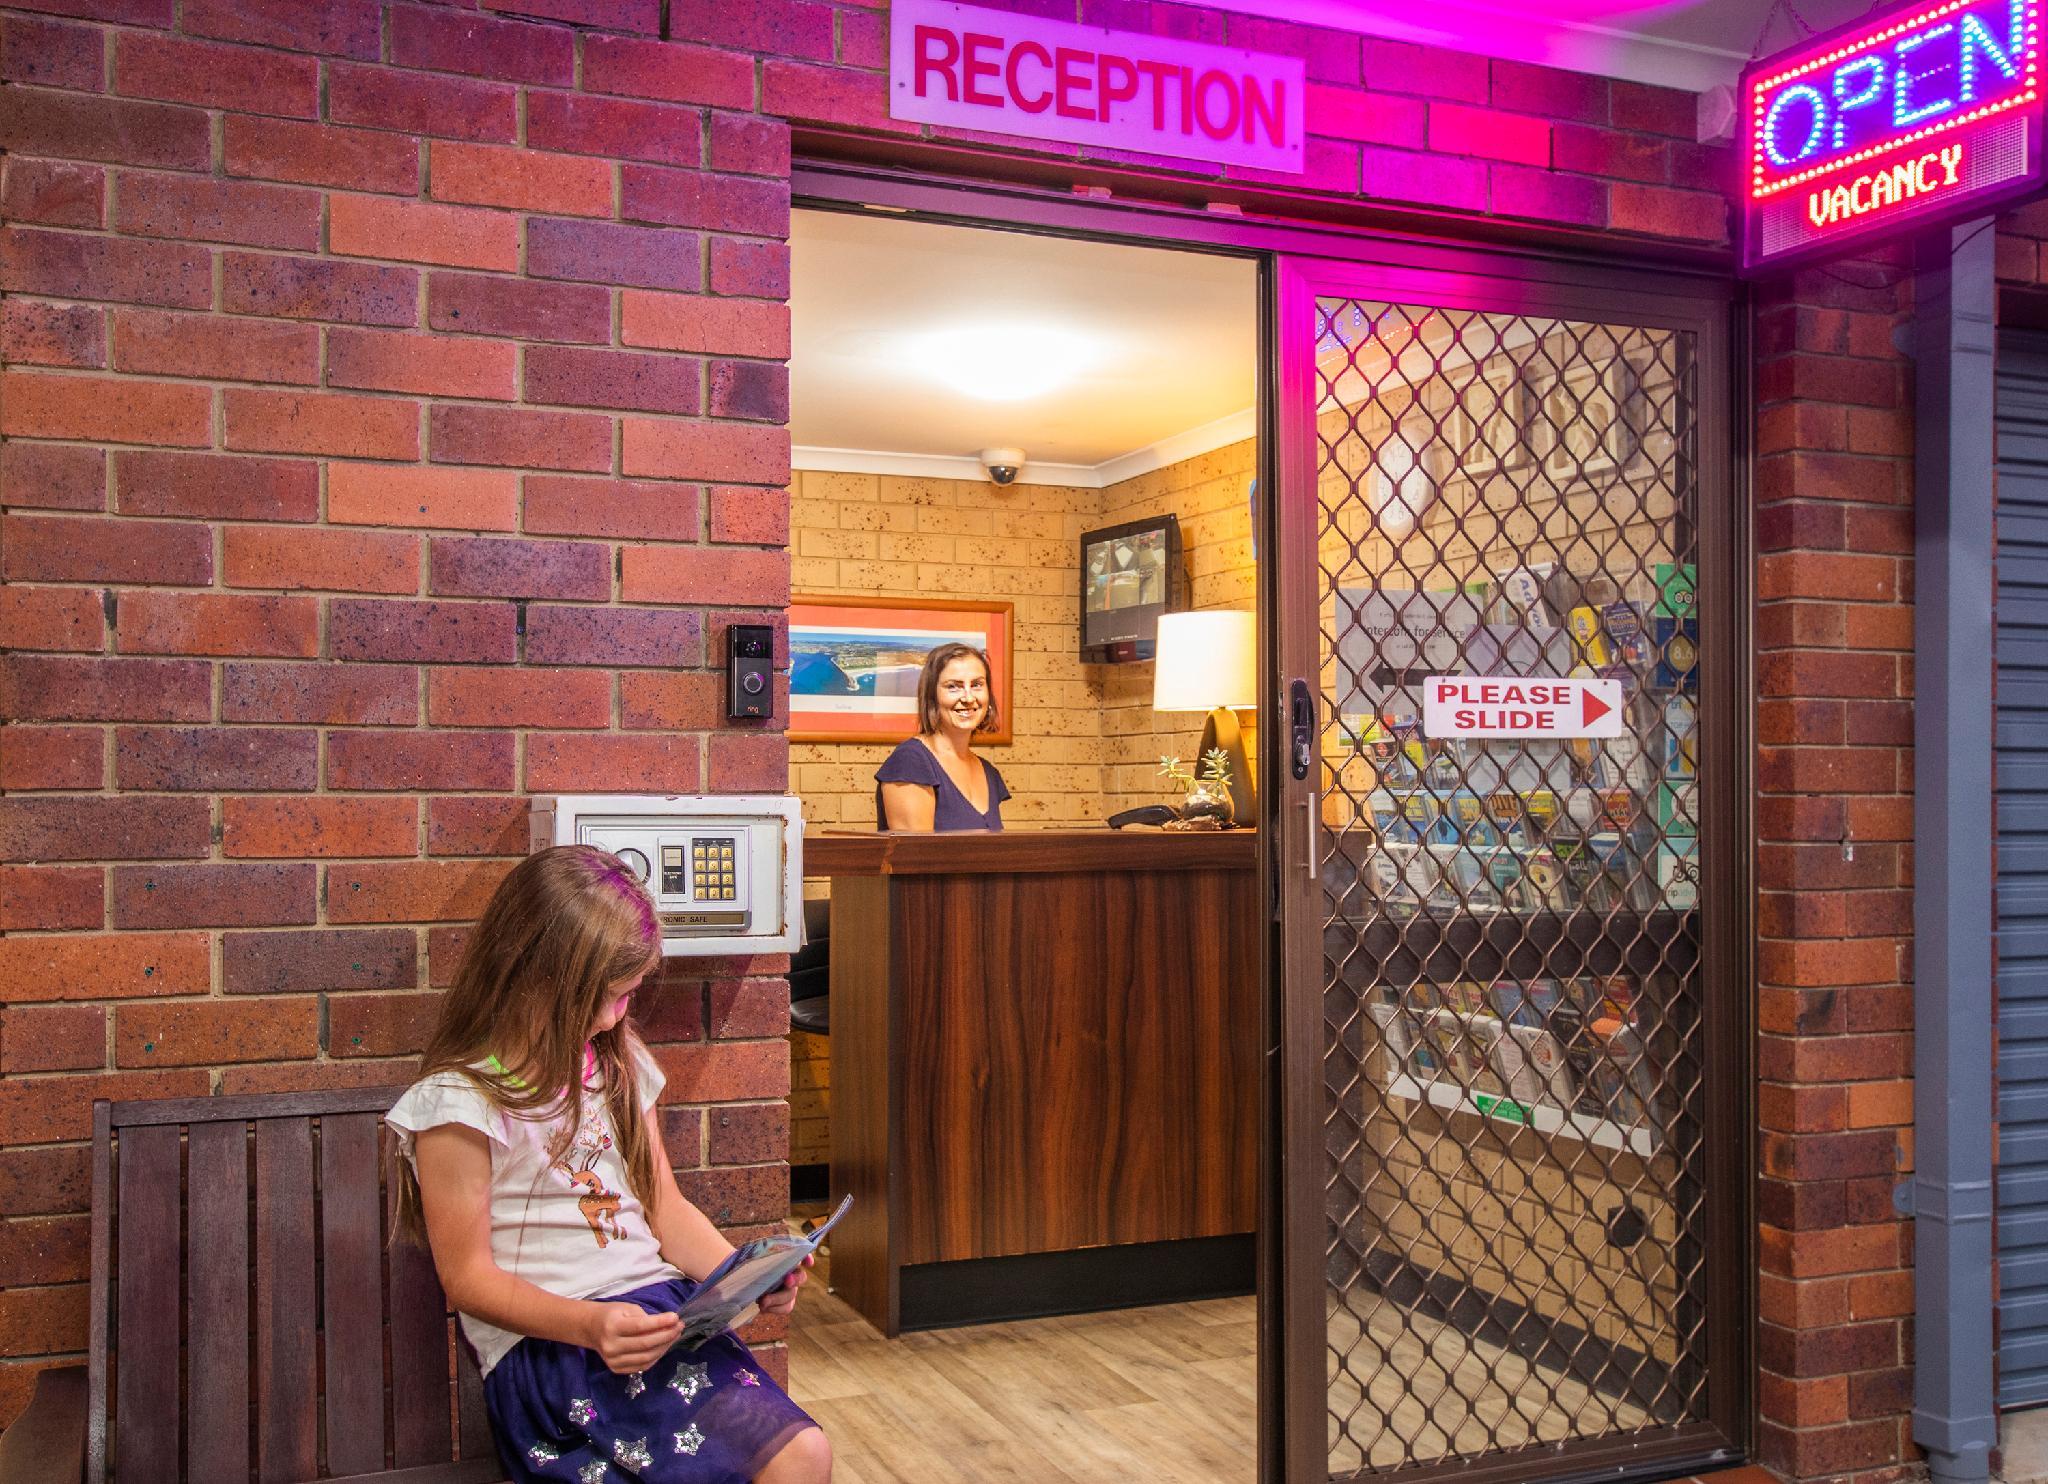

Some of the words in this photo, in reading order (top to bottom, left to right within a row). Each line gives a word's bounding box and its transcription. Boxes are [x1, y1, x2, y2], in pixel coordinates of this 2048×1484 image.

[914, 24, 1286, 148] RECEPTION
[1763, 0, 2023, 165] OPEN
[1809, 144, 1963, 227] VACANCY
[747, 705, 759, 714] ring
[1437, 684, 1571, 704] PLEASE
[1454, 710, 1555, 729] SLIDE
